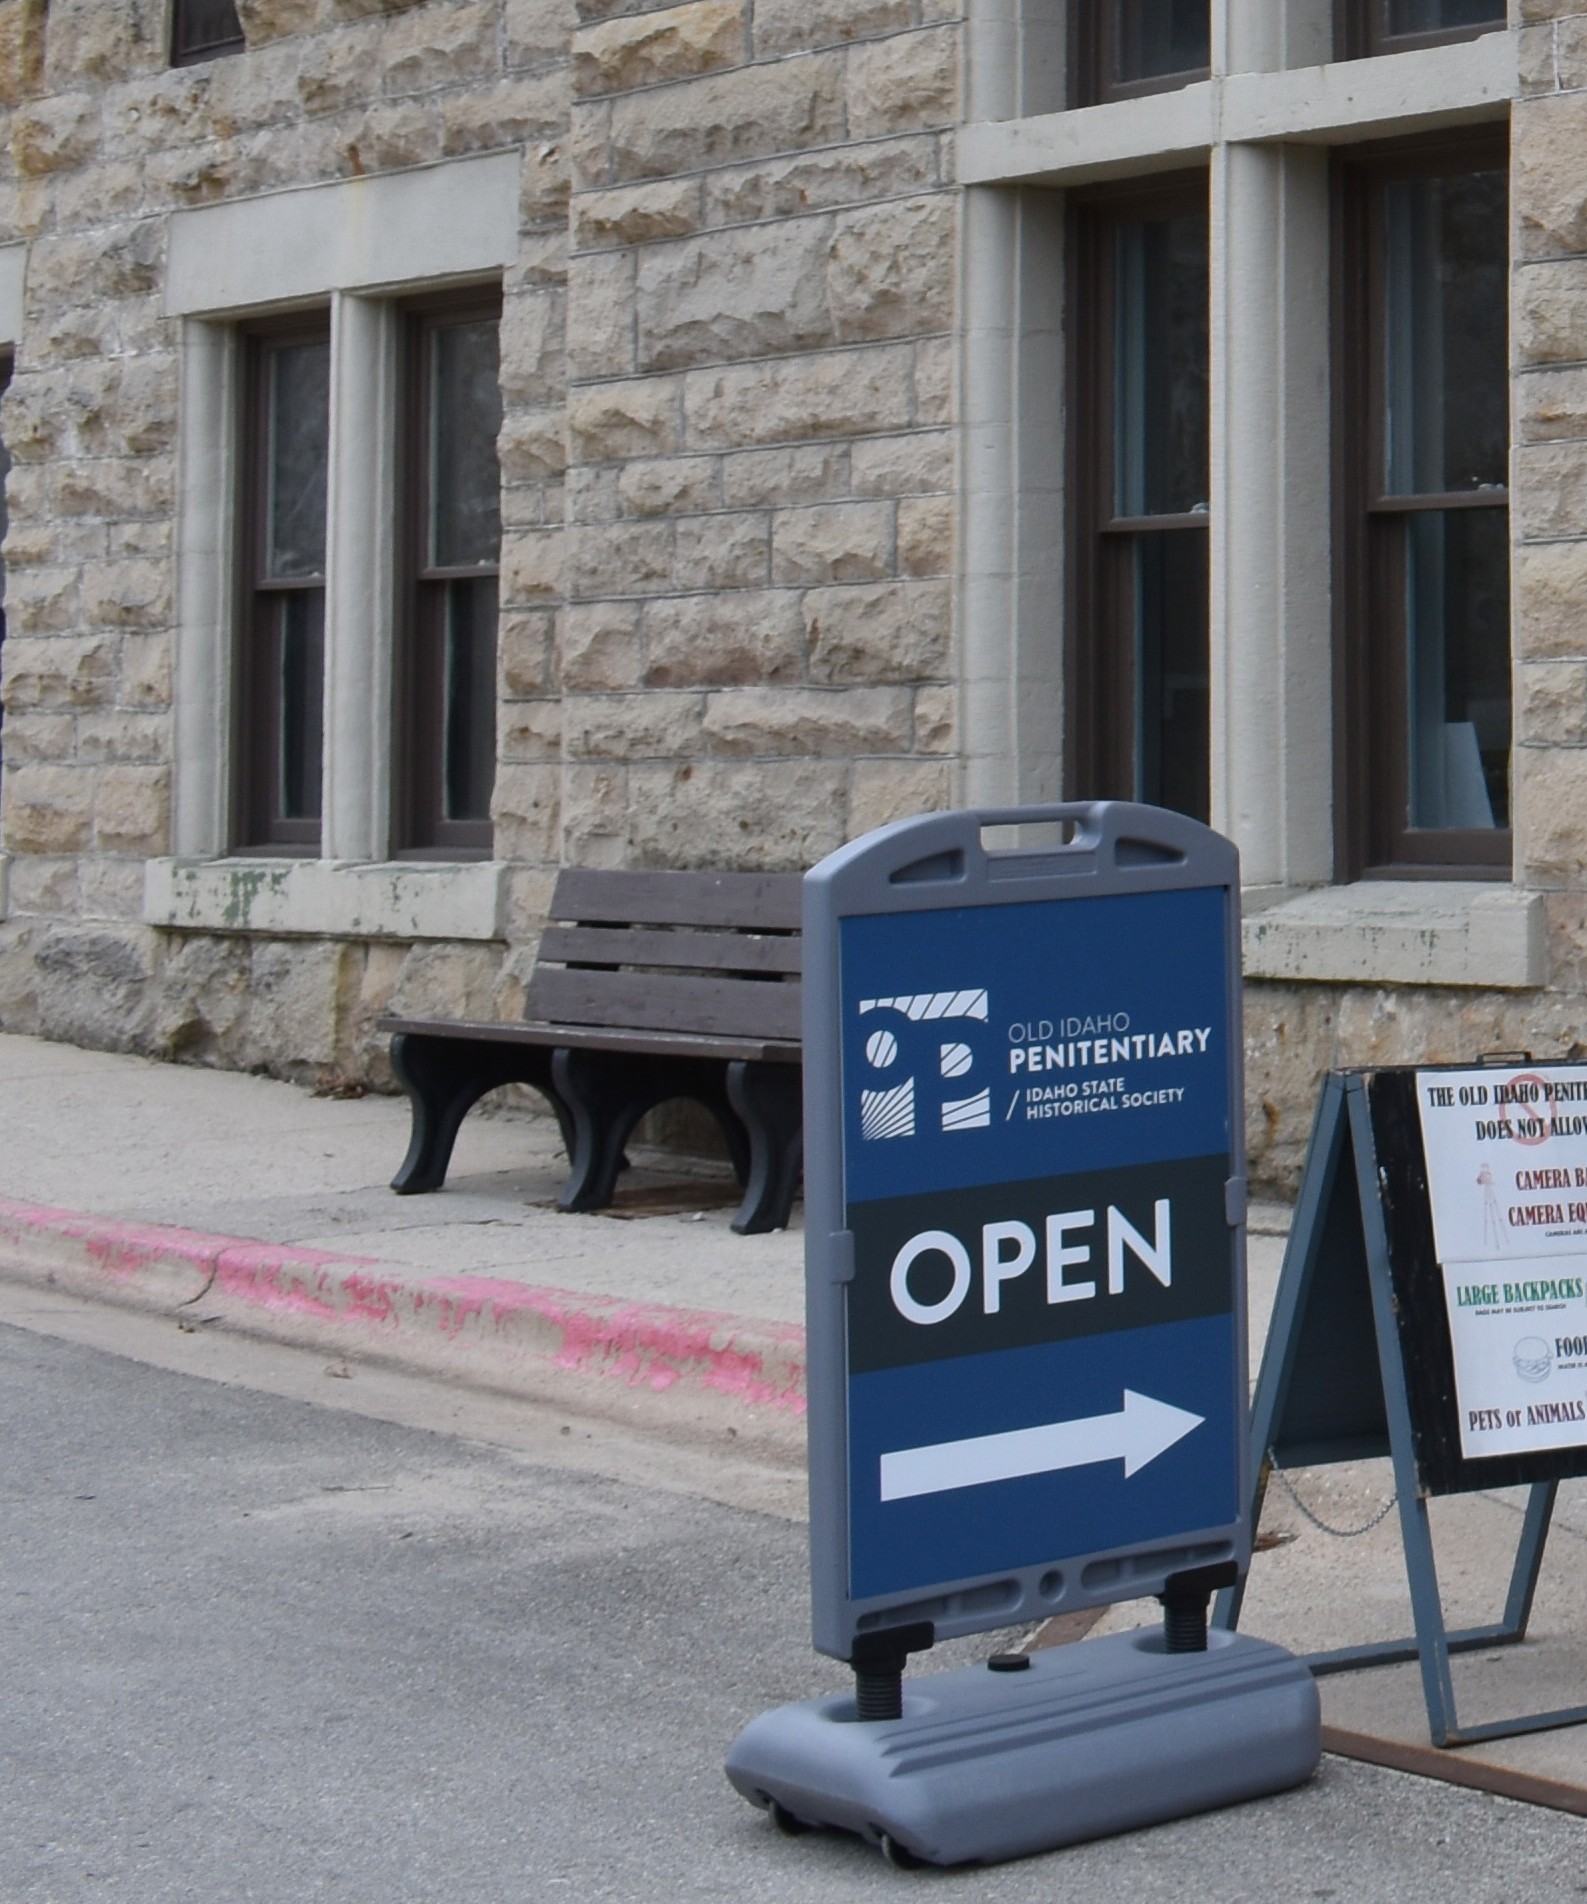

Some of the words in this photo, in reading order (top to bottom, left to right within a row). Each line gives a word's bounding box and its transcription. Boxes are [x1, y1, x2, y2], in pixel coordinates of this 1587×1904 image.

[1008, 1021, 1053, 1042] OLD
[1059, 1012, 1130, 1037] IDAHO
[1009, 1026, 1212, 1074] PENITENTIARY
[1026, 1084, 1076, 1102] IDAHO
[1081, 1078, 1125, 1097] STATE
[1026, 1098, 1118, 1120] HISTORICAL
[1122, 1087, 1184, 1107] SOCIETY
[1428, 1087, 1455, 1107] THE
[1459, 1085, 1488, 1105] OLD
[1494, 1082, 1539, 1104] IDAHO
[1476, 1119, 1513, 1141] DOES
[1517, 1118, 1545, 1138] NOT
[1515, 1169, 1571, 1191] CAMERA
[1508, 1204, 1564, 1227] CAMERA
[889, 1199, 1172, 1326] OPEN
[1457, 1283, 1499, 1307] LARGE
[1503, 1278, 1583, 1304] BACKPACKS
[1469, 1409, 1502, 1431] PETS
[1506, 1409, 1522, 1428] or
[1527, 1404, 1585, 1427] ANIMALS
